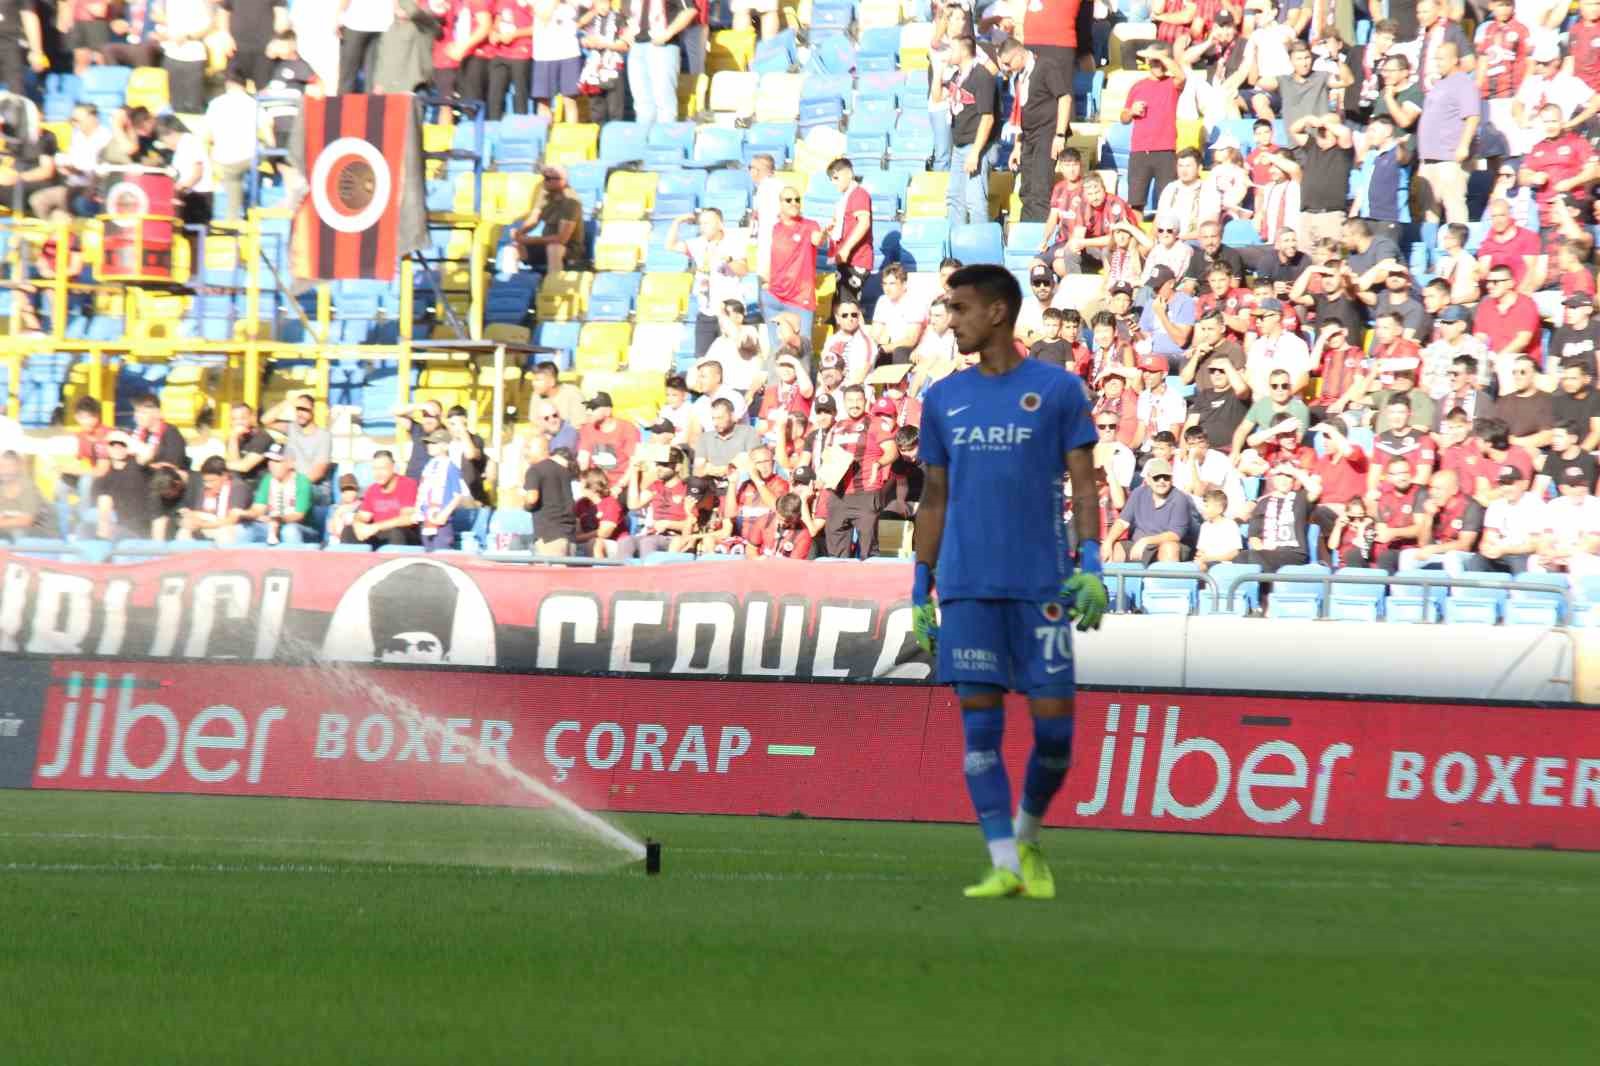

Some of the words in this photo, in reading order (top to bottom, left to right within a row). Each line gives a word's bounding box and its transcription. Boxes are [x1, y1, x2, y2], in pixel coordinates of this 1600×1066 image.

[951, 423, 1032, 446] ZARİF
[1034, 625, 1073, 660] 70
[38, 671, 288, 784] jiber
[313, 713, 515, 764] BOXER
[543, 720, 751, 783] ÇORAP
[1076, 703, 1353, 825] jiber
[1386, 750, 1600, 808] BOXER
